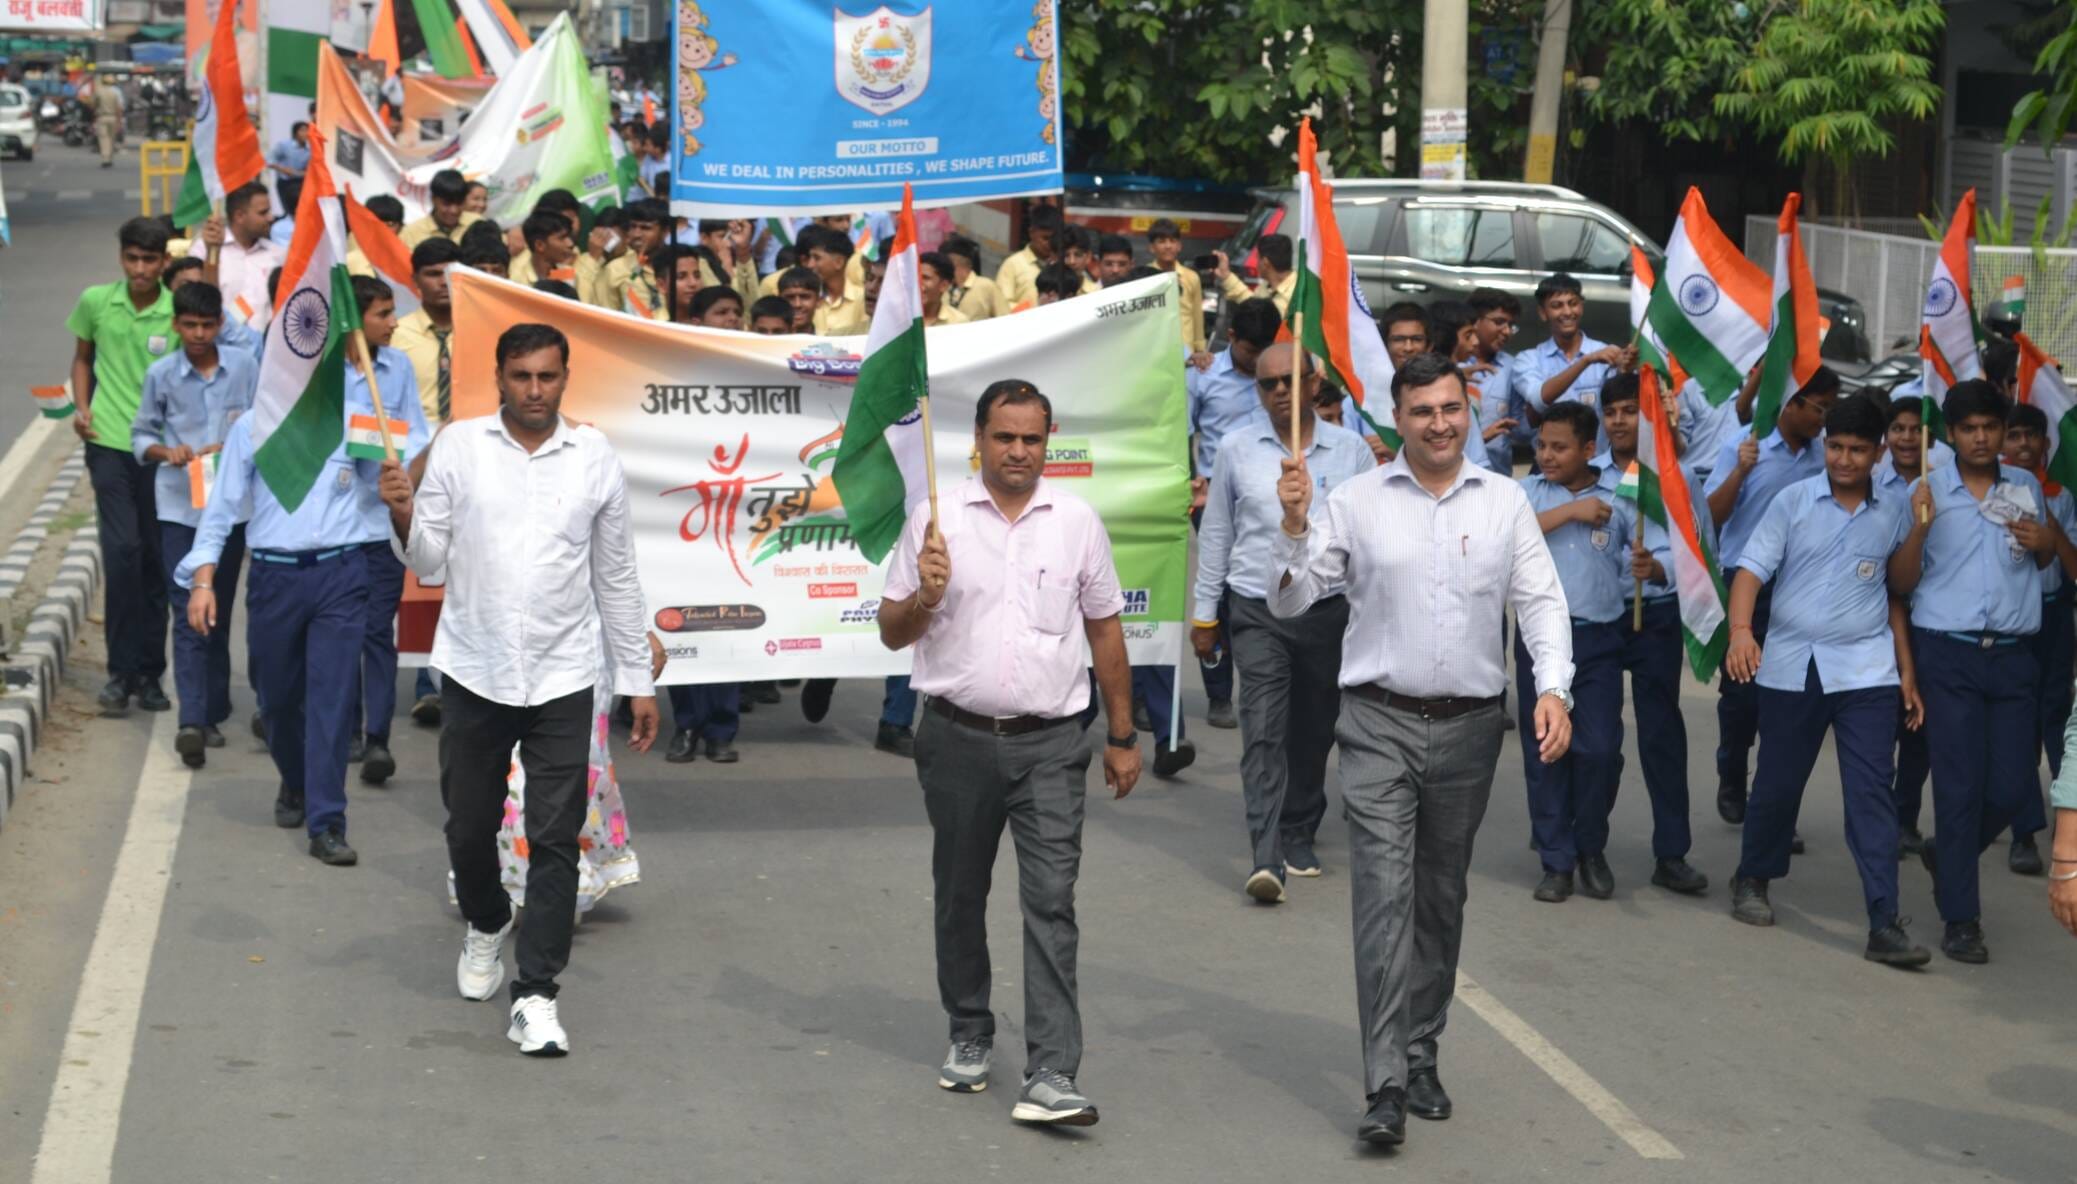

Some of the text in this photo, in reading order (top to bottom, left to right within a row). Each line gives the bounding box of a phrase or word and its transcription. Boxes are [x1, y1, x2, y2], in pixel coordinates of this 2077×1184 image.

[852, 119, 879, 129] SINCE
[849, 141, 926, 154] OUR MOTTO
[703, 163, 728, 176] WE
[731, 164, 771, 178] DEAL
[776, 166, 794, 179] IN
[925, 160, 947, 173] WE
[951, 157, 994, 172] SHAPE
[998, 151, 1048, 167] FUTURE.
[640, 383, 802, 415] अमर उजाला
[1055, 448, 1088, 460] POINT
[747, 474, 817, 533] तुझे
[809, 583, 856, 596] Co Sponsor
[1122, 590, 1147, 603] HA
[1123, 604, 1147, 613] UTE
[664, 646, 698, 657] ssions
